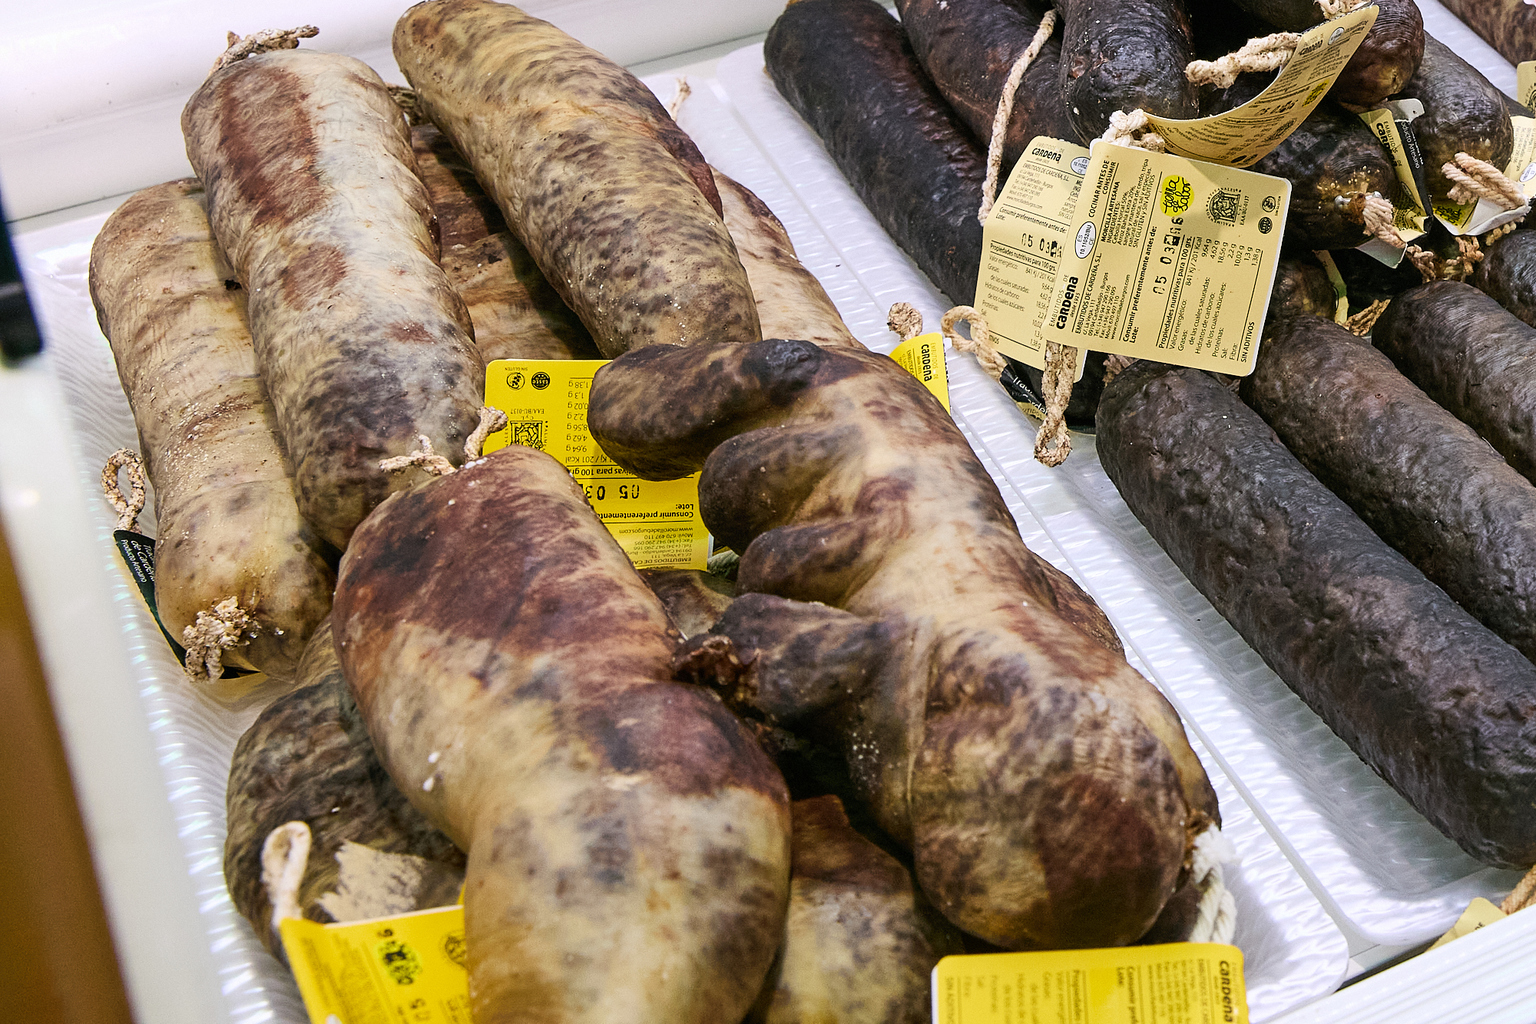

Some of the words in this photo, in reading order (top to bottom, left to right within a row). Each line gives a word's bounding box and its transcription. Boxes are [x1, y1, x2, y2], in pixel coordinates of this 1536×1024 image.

[1383, 120, 1399, 155] EMBUTIDOS
[1102, 161, 1117, 195] CONSUMIR
[1088, 189, 1101, 218] COCINAR
[1096, 169, 1107, 190] ANTES
[1102, 160, 1110, 170] DE
[1144, 174, 1156, 201] ADITIVOS
[1100, 212, 1113, 243] MORCILLA
[1108, 181, 1121, 212] ARTESANA
[1128, 197, 1138, 222] manteca
[1141, 200, 1149, 211] SIN
[1106, 202, 1121, 244] INGREDIENTES:
[1111, 223, 1121, 245] Cebolla
[1116, 204, 1126, 223] Horcal
[1135, 215, 1145, 238] GLUTEN
[1149, 226, 1158, 237] de:
[1132, 237, 1140, 248] SIN
[1145, 238, 1155, 256] antes
[1184, 236, 1193, 249] grs.
[1194, 236, 1203, 250] Kcal
[1180, 248, 1189, 261] 100
[1191, 250, 1199, 263] 201
[1209, 245, 1218, 259] 4,62
[1227, 248, 1235, 259] 2,2
[1233, 250, 1243, 267] 10,02
[1086, 263, 1100, 292] CARDEÑA,
[1177, 261, 1186, 278] para
[1099, 272, 1109, 290] Burgos
[1131, 255, 1150, 312] preferentemente
[1185, 274, 1193, 287] 841
[1048, 289, 1065, 328] EMBUTIDOS
[1062, 274, 1069, 283] DE
[1084, 292, 1092, 301] DE
[1170, 277, 1182, 309] nutritivas
[1177, 329, 1189, 352] Grasas:
[1201, 244, 1210, 258] 9,64
[1194, 328, 1207, 355] Hidratos
[1204, 292, 1216, 320] carbono:
[1217, 247, 1227, 264] 18,56
[1198, 277, 1211, 308] saturadas:
[1220, 347, 1228, 359] Sal:
[1243, 252, 1251, 261] 1,3
[1228, 342, 1238, 361] Fibra:
[1251, 253, 1259, 266] 1,38
[1074, 300, 1089, 335] EMBUTIDOS
[1122, 311, 1136, 342] Consumir
[1193, 308, 1203, 328] cuales
[1210, 310, 1220, 330] cuales
[1129, 326, 1139, 344] Lote:
[1158, 309, 1175, 349] Propiedades
[1189, 327, 1198, 336] las
[1206, 330, 1215, 340] los
[1243, 321, 1255, 352] ADITIVOS
[1168, 333, 1178, 350] Valor
[1188, 336, 1196, 346] de
[1240, 351, 1248, 363] SIN
[572, 434, 588, 442] 4,62
[572, 445, 588, 453] 9,64
[565, 456, 580, 464] Kcal
[582, 456, 595, 464] 201
[580, 468, 595, 476] 100
[596, 467, 613, 475] para
[619, 484, 640, 500] 05
[659, 511, 694, 519] Consumir
[675, 503, 694, 511] Lote:
[120, 539, 136, 562] Producto
[132, 560, 147, 583] Artesano
